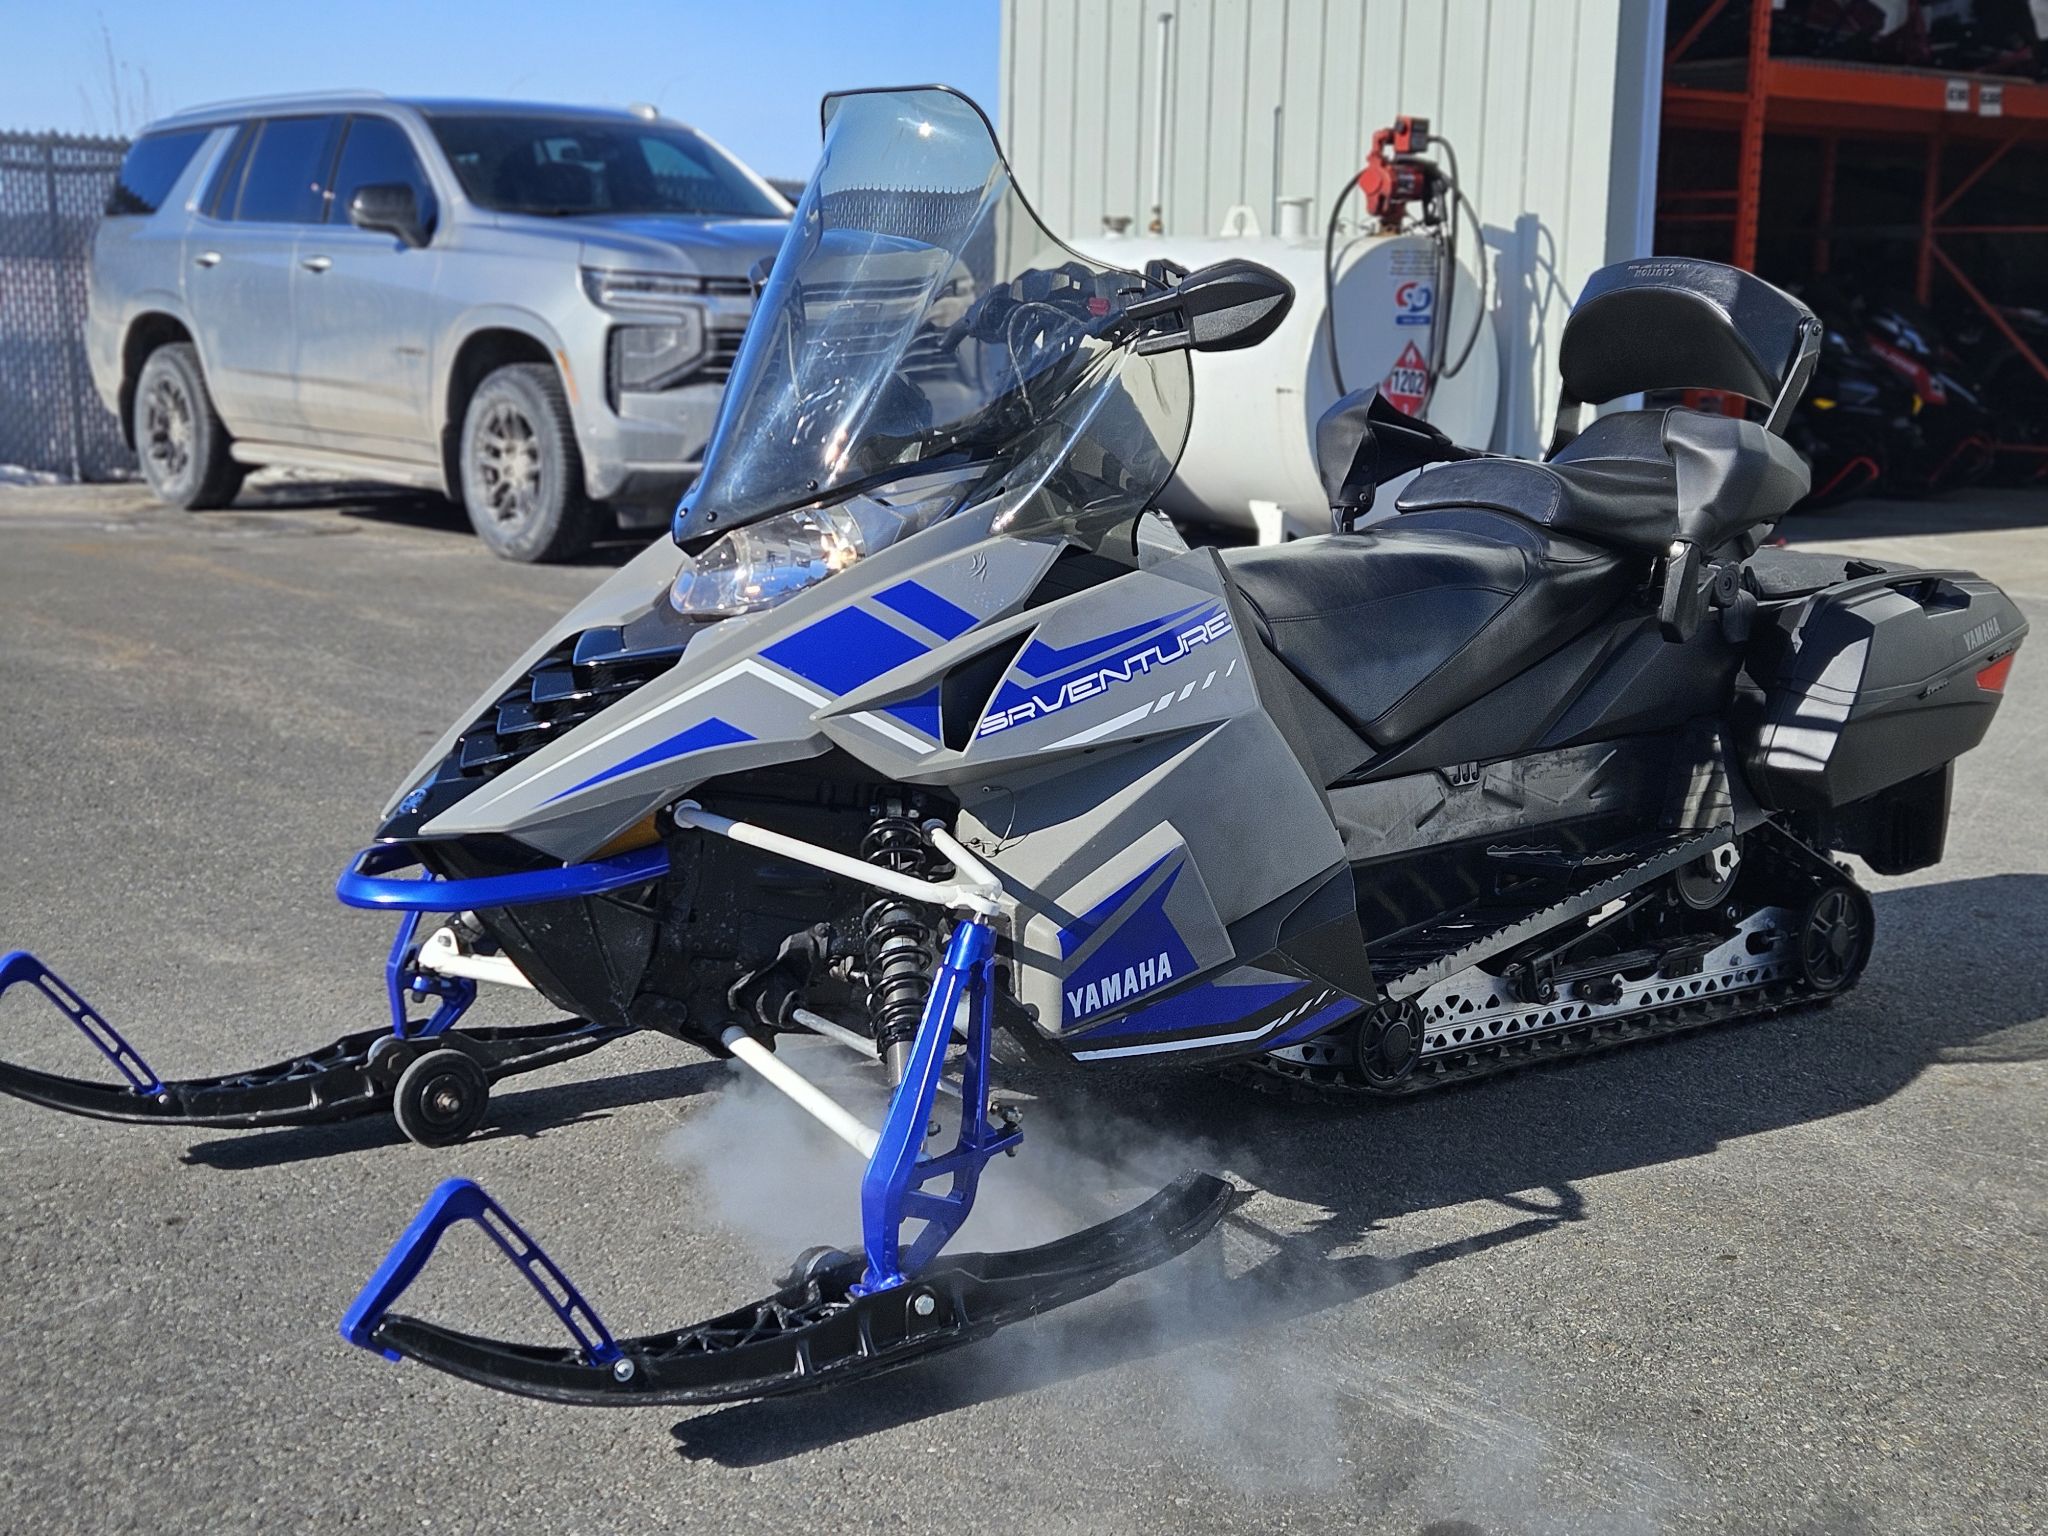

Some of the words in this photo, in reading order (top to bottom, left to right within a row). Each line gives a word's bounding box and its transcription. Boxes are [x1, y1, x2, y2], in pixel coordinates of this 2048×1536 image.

[1634, 268, 1674, 278] CAUTION
[1394, 370, 1424, 395] 1202
[1963, 617, 2002, 651] YAMAHA
[980, 611, 1233, 736] SRVENTURE
[1066, 952, 1173, 1018] YAMAHA
